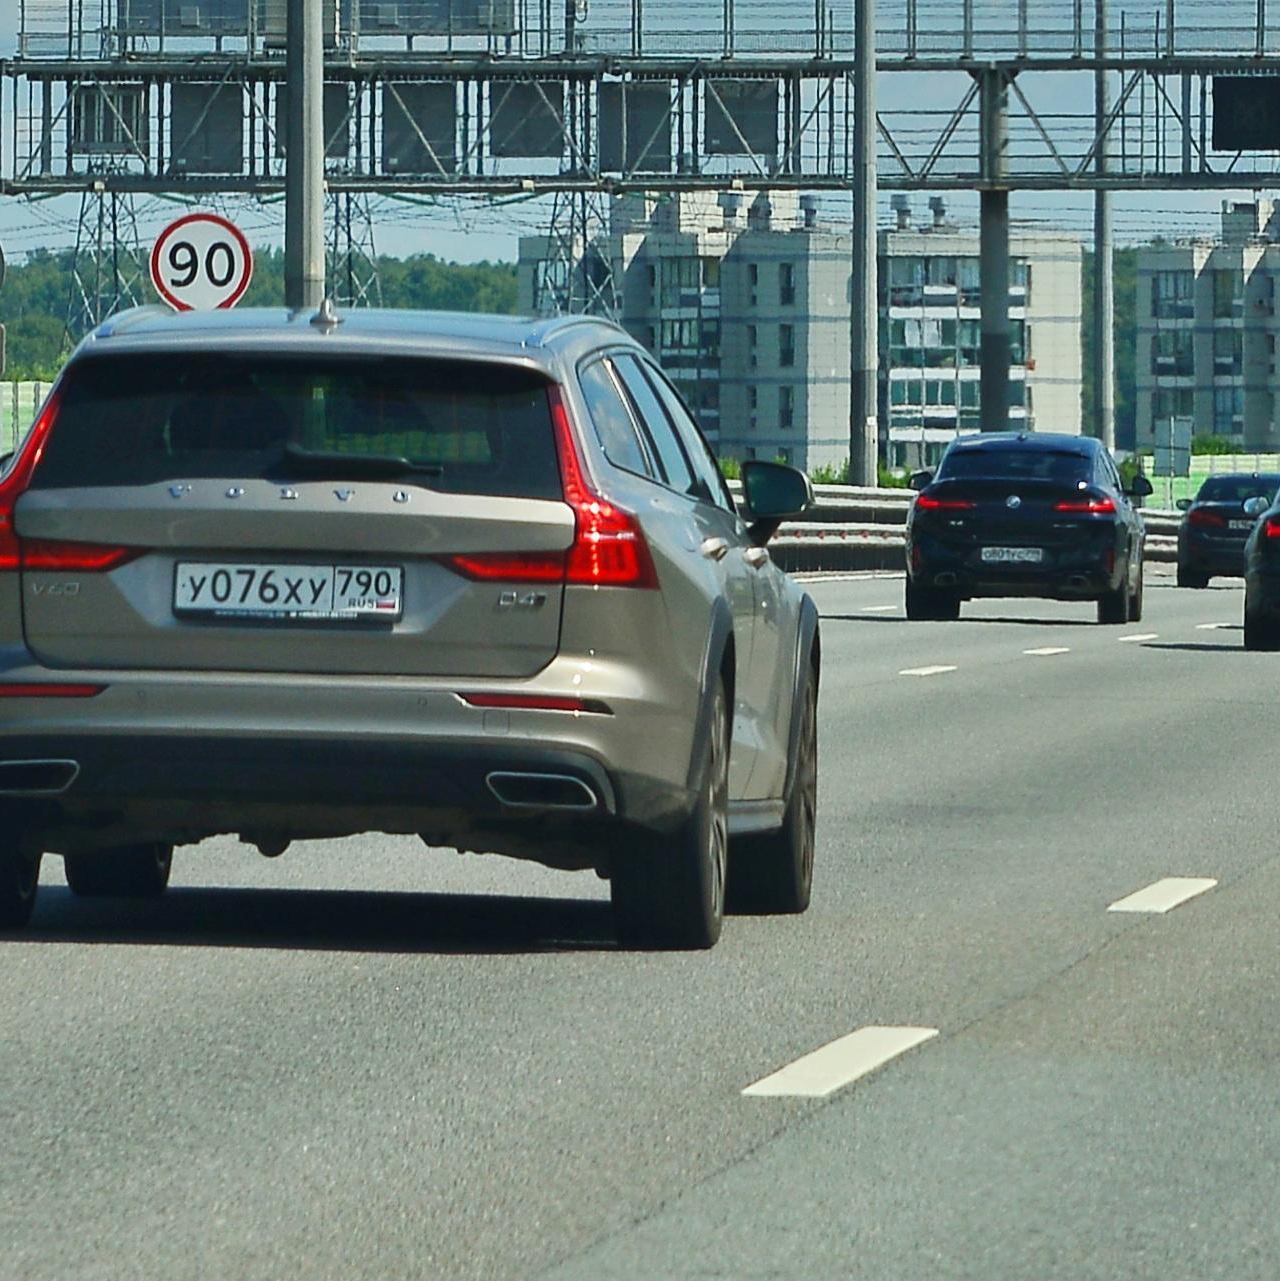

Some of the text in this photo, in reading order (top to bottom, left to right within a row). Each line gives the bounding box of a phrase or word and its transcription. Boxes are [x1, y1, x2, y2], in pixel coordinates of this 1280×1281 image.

[169, 241, 235, 288] 90
[337, 570, 392, 597] 790
[348, 598, 375, 608] RUS
